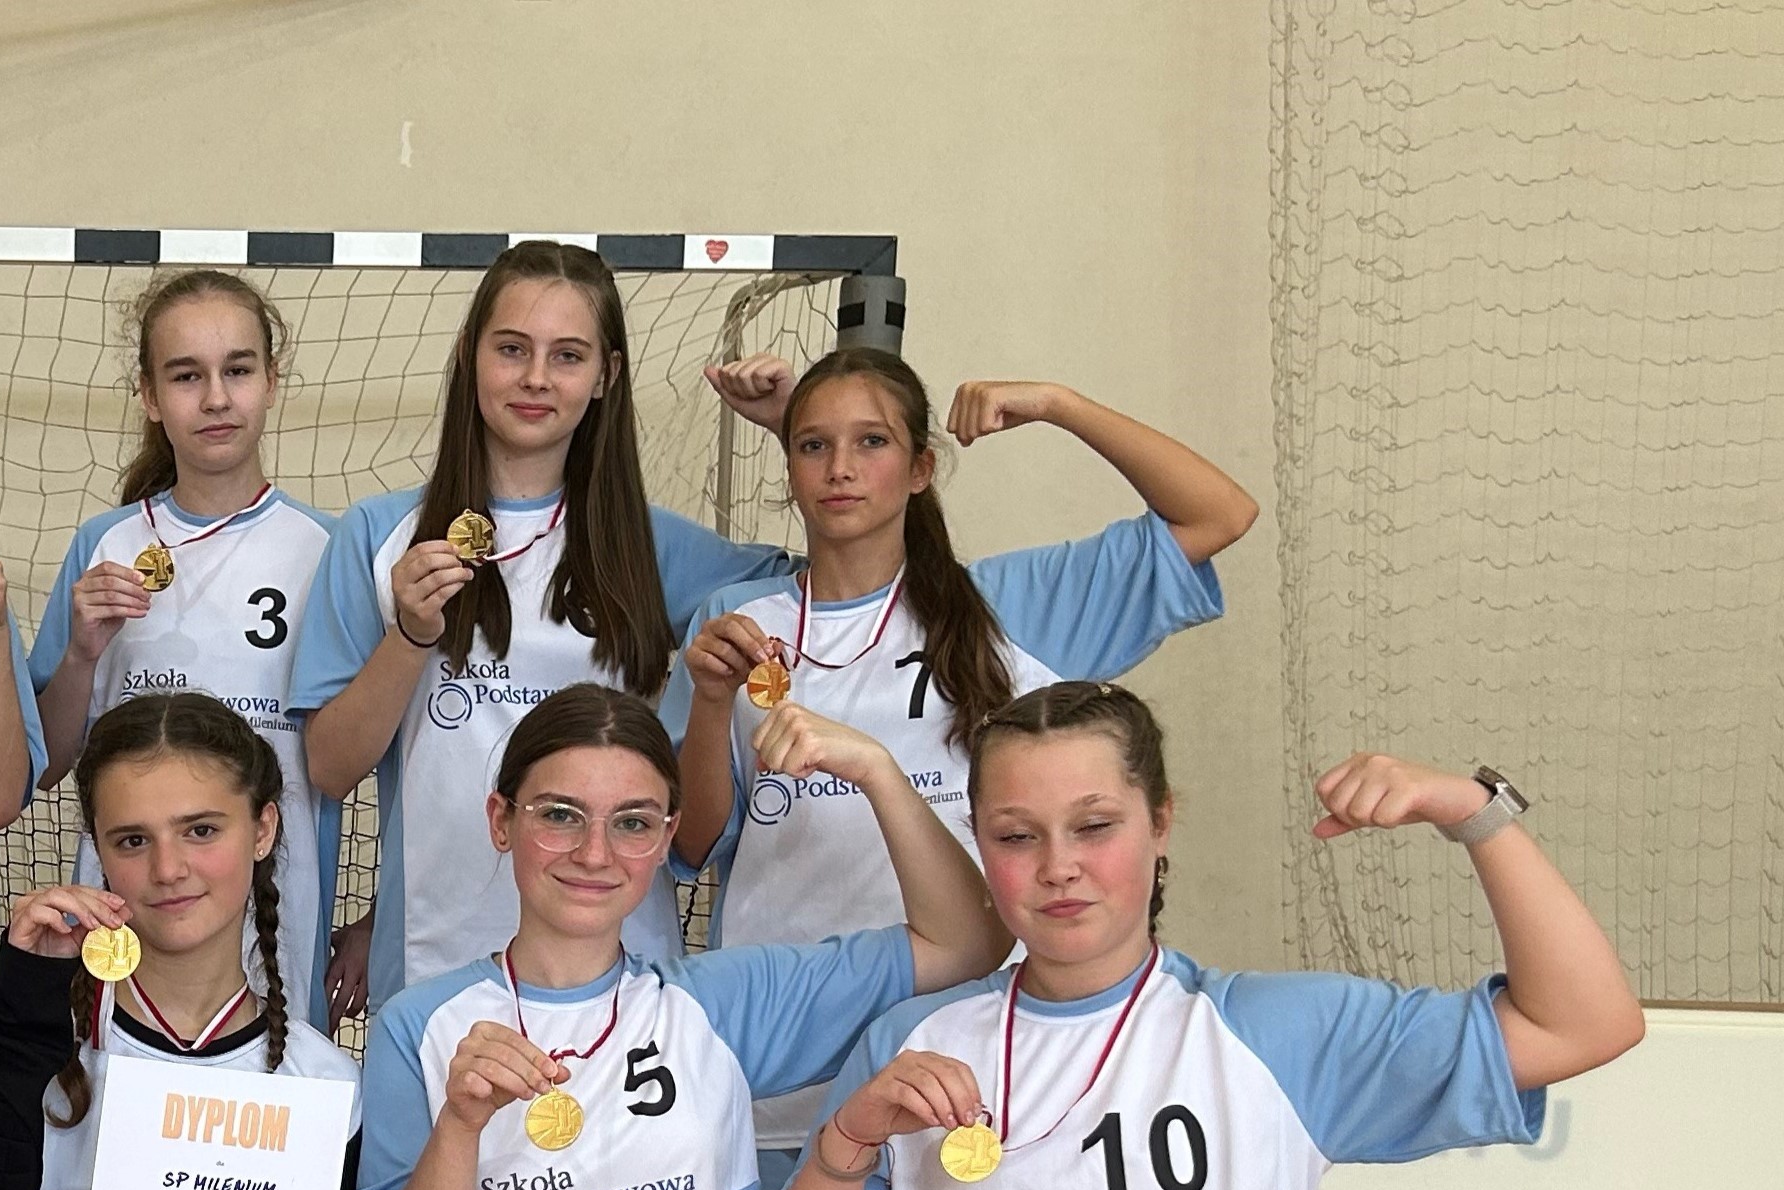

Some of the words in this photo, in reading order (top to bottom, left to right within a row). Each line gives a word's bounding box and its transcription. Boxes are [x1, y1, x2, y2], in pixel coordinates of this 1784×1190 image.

[244, 587, 288, 649] 3
[122, 668, 187, 690] Szkoła
[895, 650, 933, 719] 7
[623, 1040, 677, 1117] 5
[161, 1092, 291, 1152] DYPLOM
[162, 1171, 190, 1188] SP
